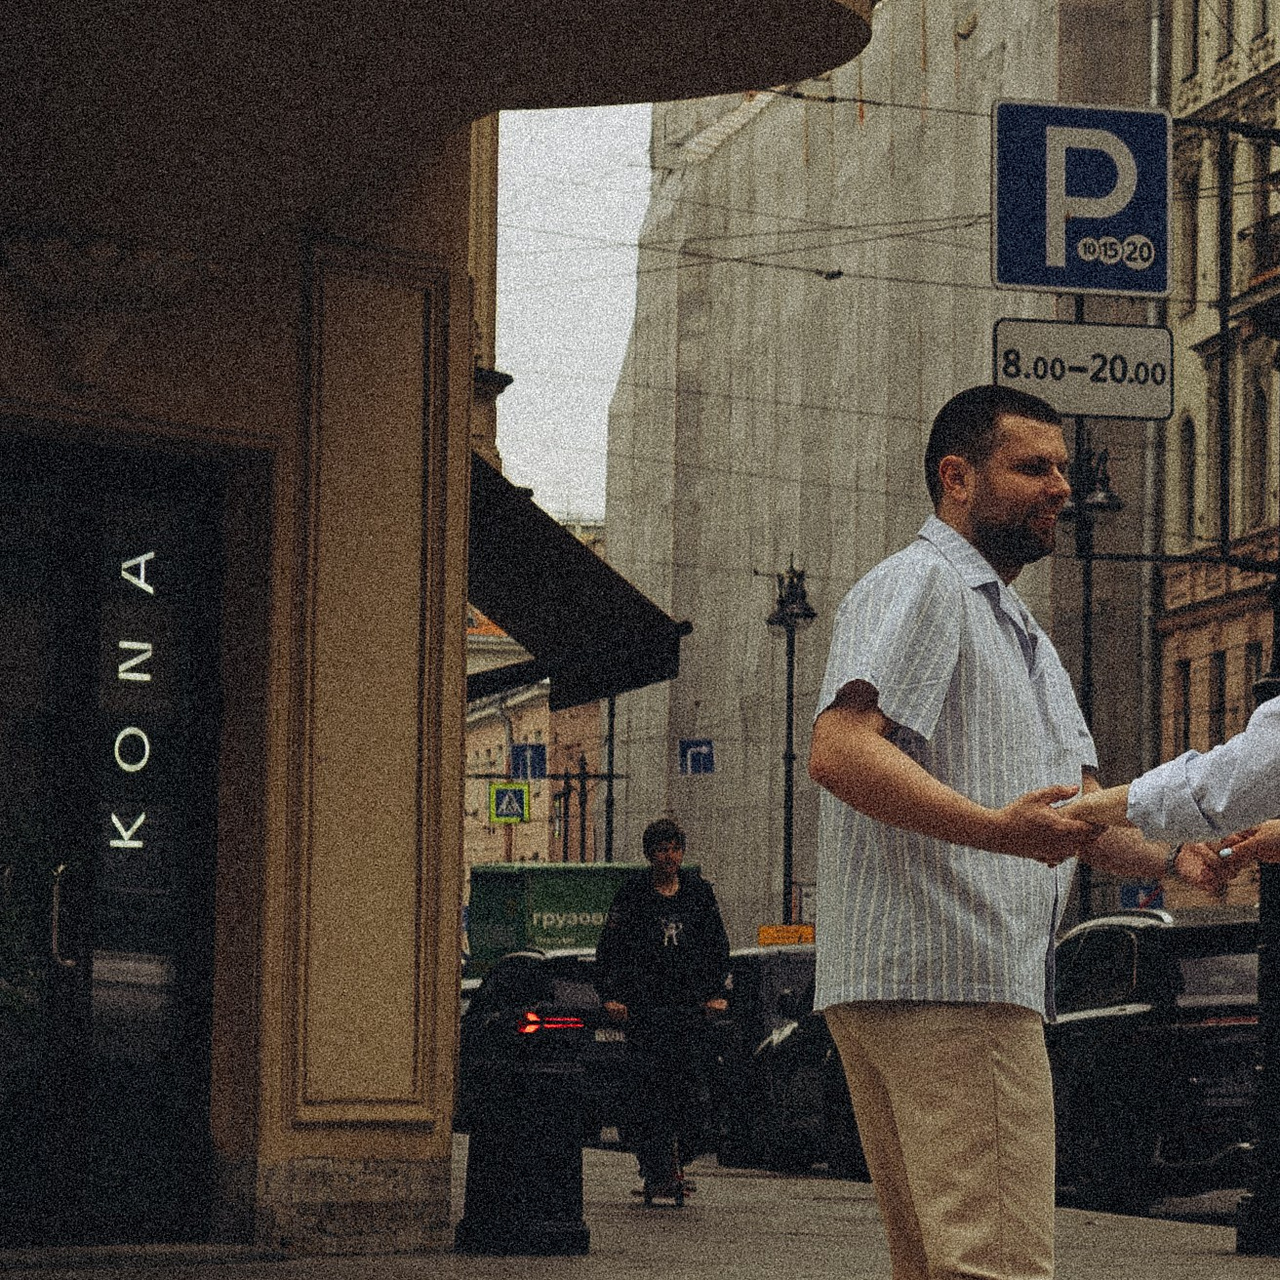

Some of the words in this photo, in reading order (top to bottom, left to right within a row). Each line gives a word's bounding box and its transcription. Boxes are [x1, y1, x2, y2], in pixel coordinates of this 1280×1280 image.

[1046, 125, 1138, 268] P
[1125, 240, 1153, 263] 20
[109, 552, 155, 848] KONA
